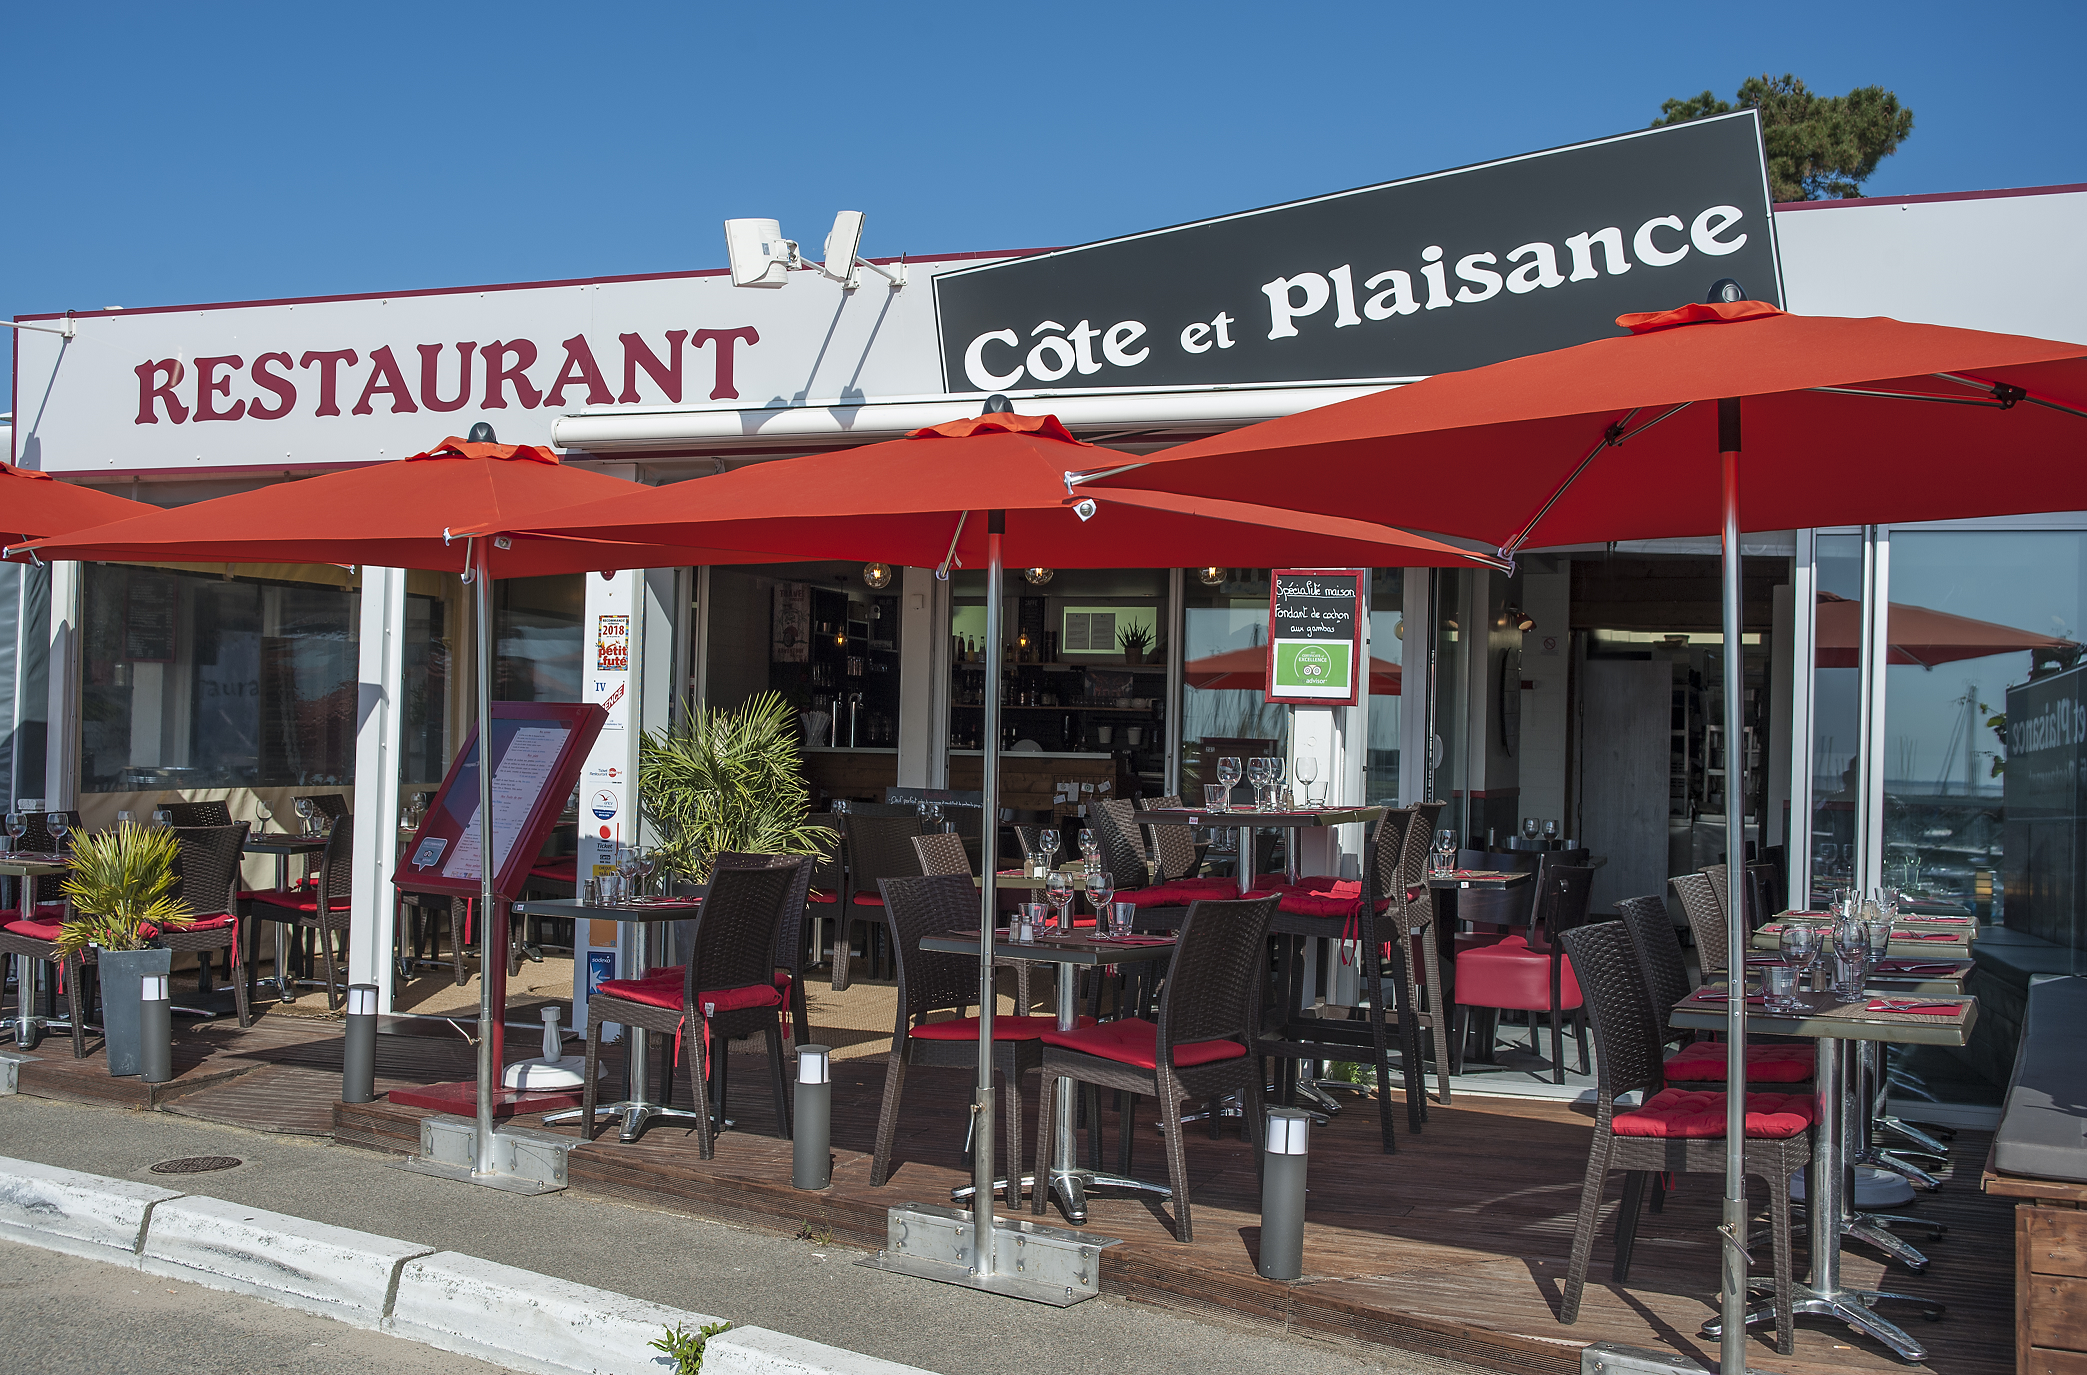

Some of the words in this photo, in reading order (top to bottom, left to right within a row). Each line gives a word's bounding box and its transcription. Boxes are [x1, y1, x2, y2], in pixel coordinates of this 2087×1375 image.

[964, 319, 1151, 392] Côte
[1180, 311, 1236, 355] et
[1261, 204, 1749, 341] Plaisance
[134, 326, 760, 426] RESTAURANT
[1324, 585, 1356, 598] maison
[1275, 603, 1309, 619] Fondant
[1310, 608, 1321, 619] de
[602, 625, 625, 636] 2018
[1306, 621, 1336, 637] gambas
[598, 645, 628, 658] petit
[603, 655, 627, 667] futé
[602, 685, 625, 712] ENCE
[591, 955, 611, 964] sodexo
